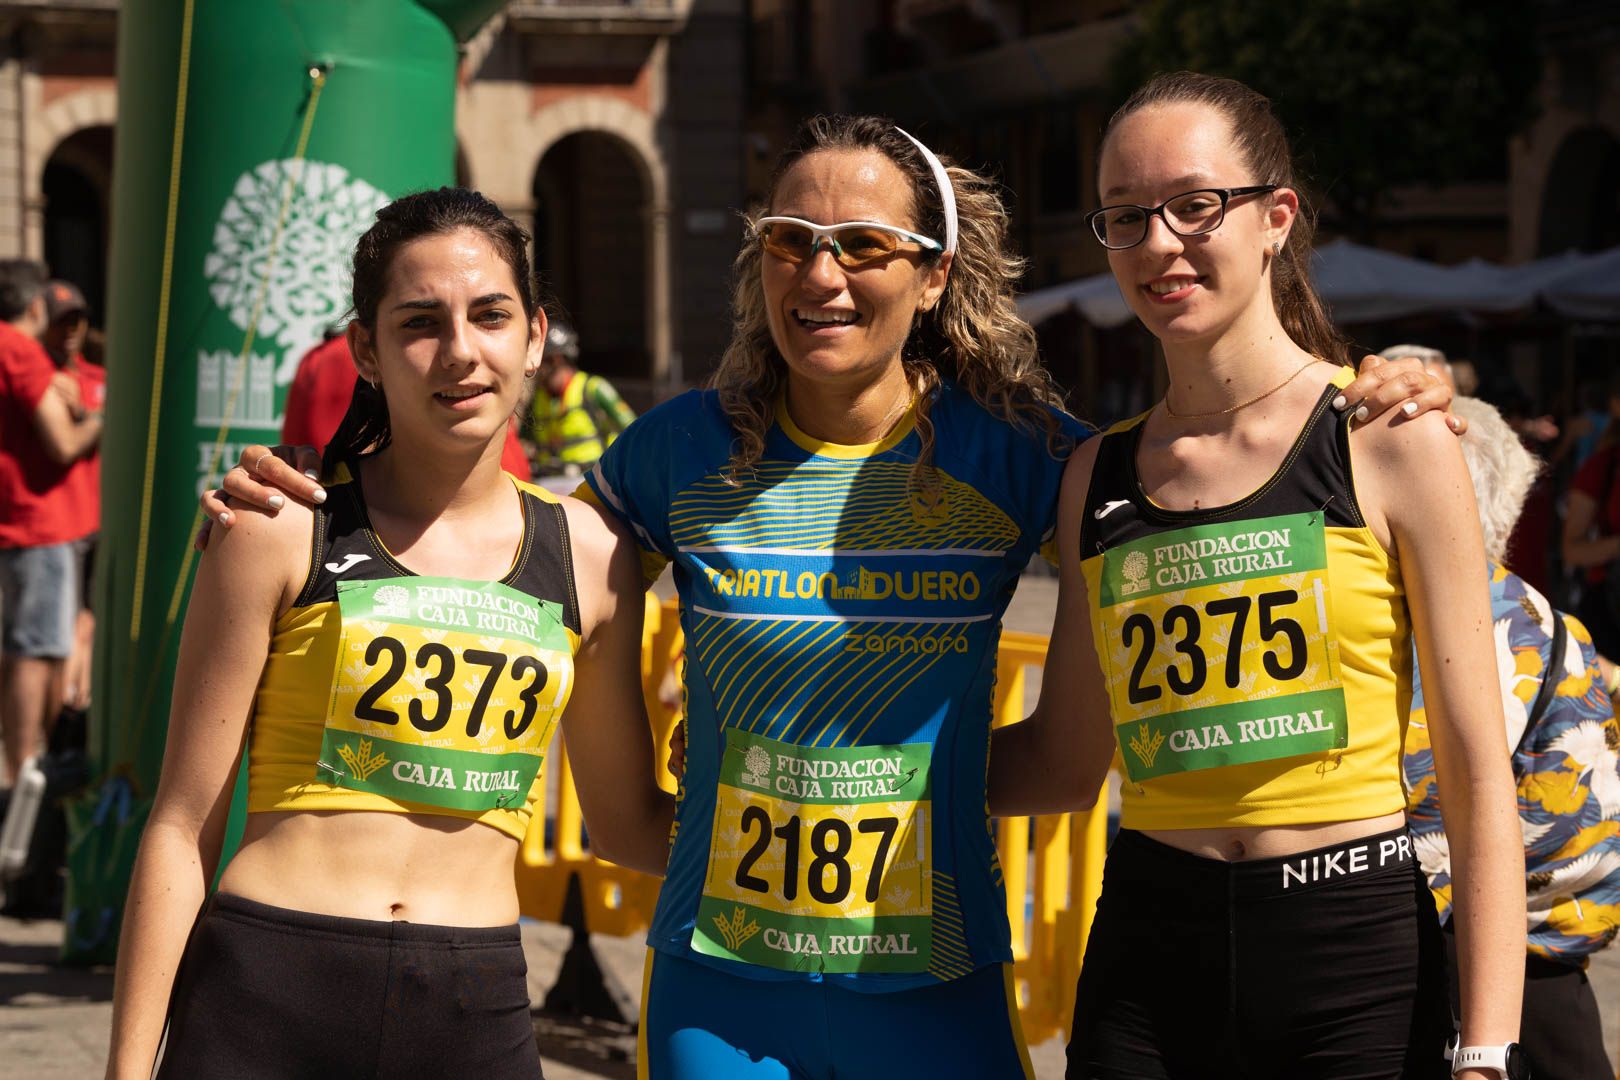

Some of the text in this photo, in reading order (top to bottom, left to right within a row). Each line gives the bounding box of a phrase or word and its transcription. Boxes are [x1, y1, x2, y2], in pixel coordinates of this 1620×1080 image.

[1153, 528, 1291, 566] FUNDACION
[704, 567, 980, 600] TRIATLON DUERO
[1155, 550, 1292, 587] CAJA RURAL
[415, 586, 540, 626] FUNDACION
[417, 604, 541, 642] CAJA RURAL
[844, 633, 968, 654] zamora
[1121, 589, 1308, 705] 2375
[354, 636, 548, 740] 2373
[1168, 709, 1334, 753] CAJA RURAL
[392, 761, 520, 792] CAJA RURAL
[776, 754, 902, 779] FUNDACION
[775, 777, 901, 798] CAJA RURAL
[735, 805, 899, 905] 2187
[1282, 834, 1412, 889] NIKE PR
[763, 928, 917, 955] CAJA RURAL
